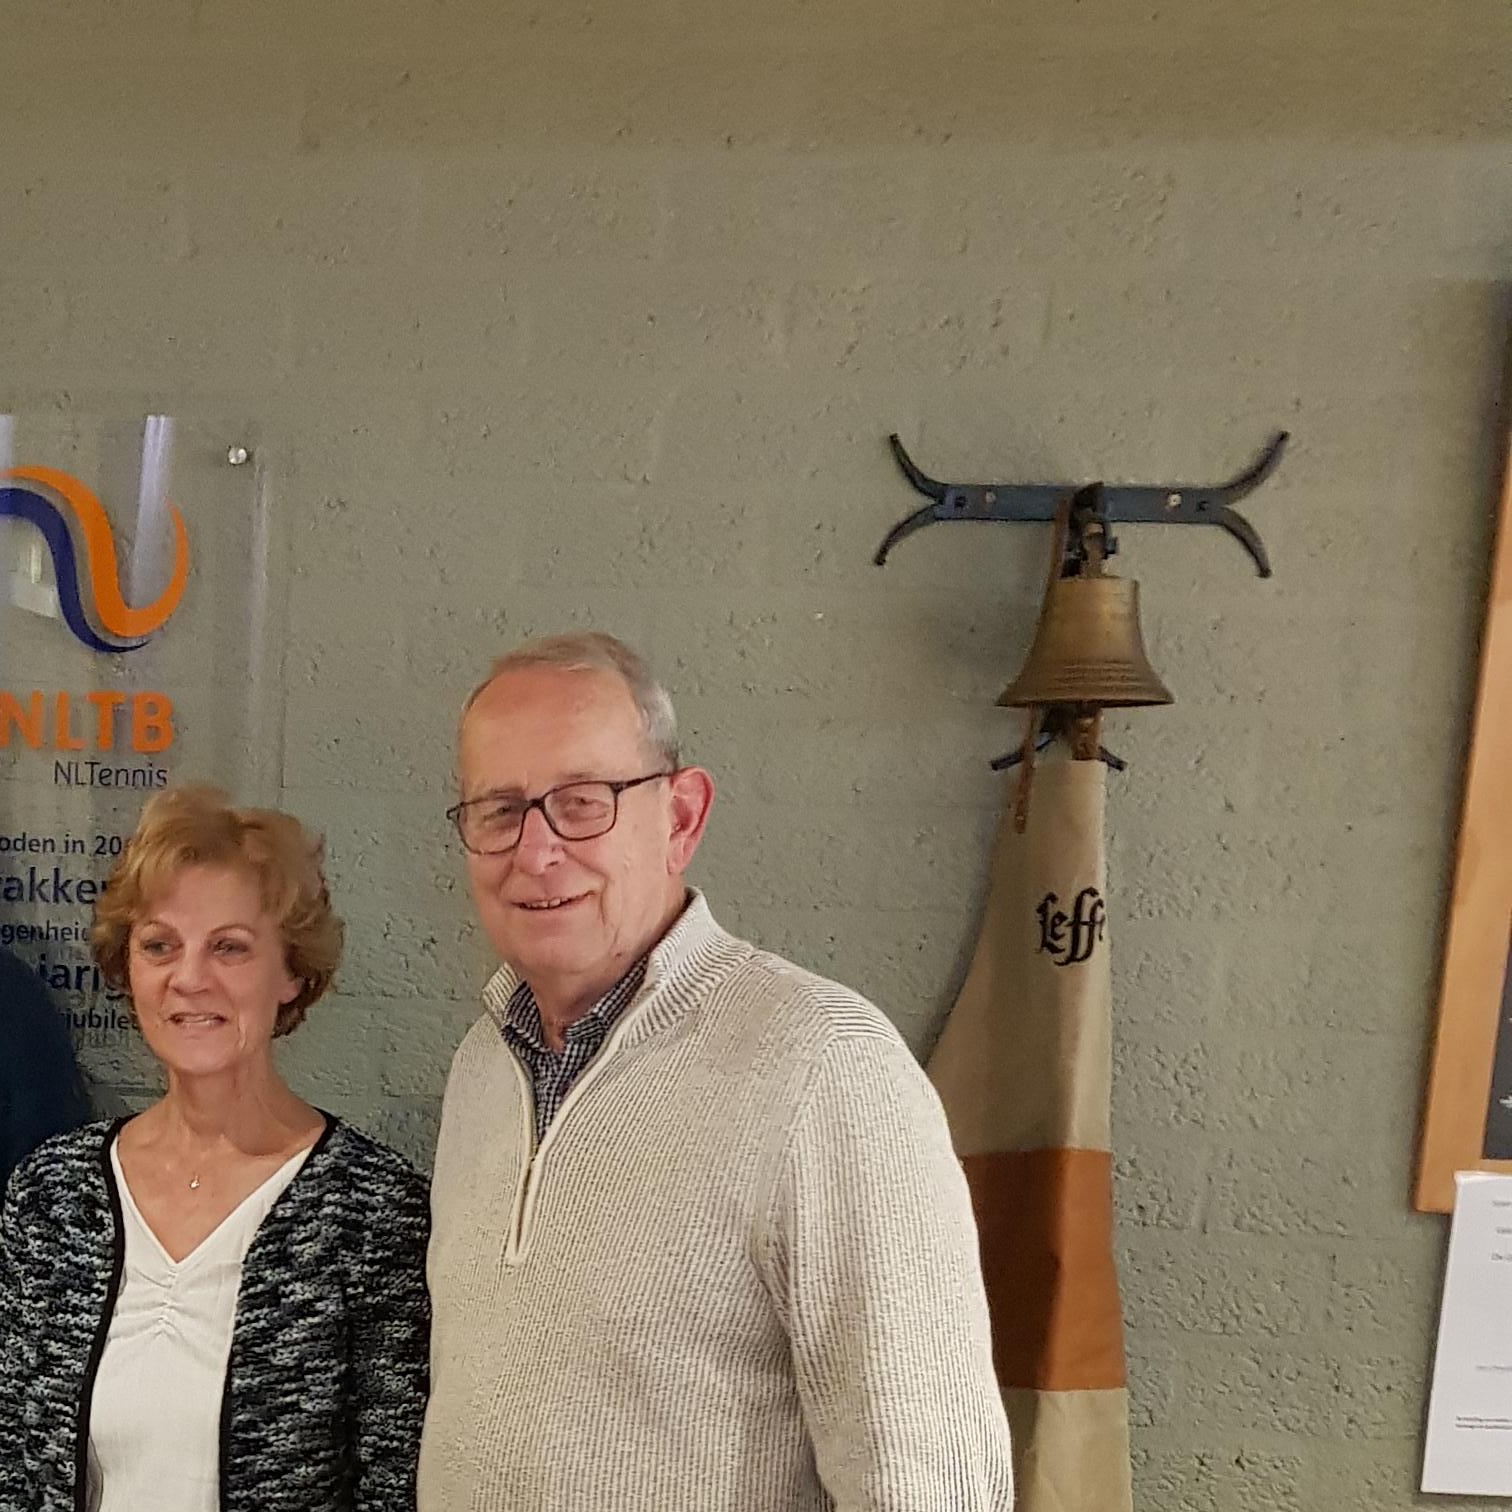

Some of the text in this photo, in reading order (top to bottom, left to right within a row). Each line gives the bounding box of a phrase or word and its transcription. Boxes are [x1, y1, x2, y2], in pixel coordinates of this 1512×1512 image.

[64, 833, 85, 855] in
[94, 835, 123, 856] 20
[59, 1008, 138, 1031] jubile
